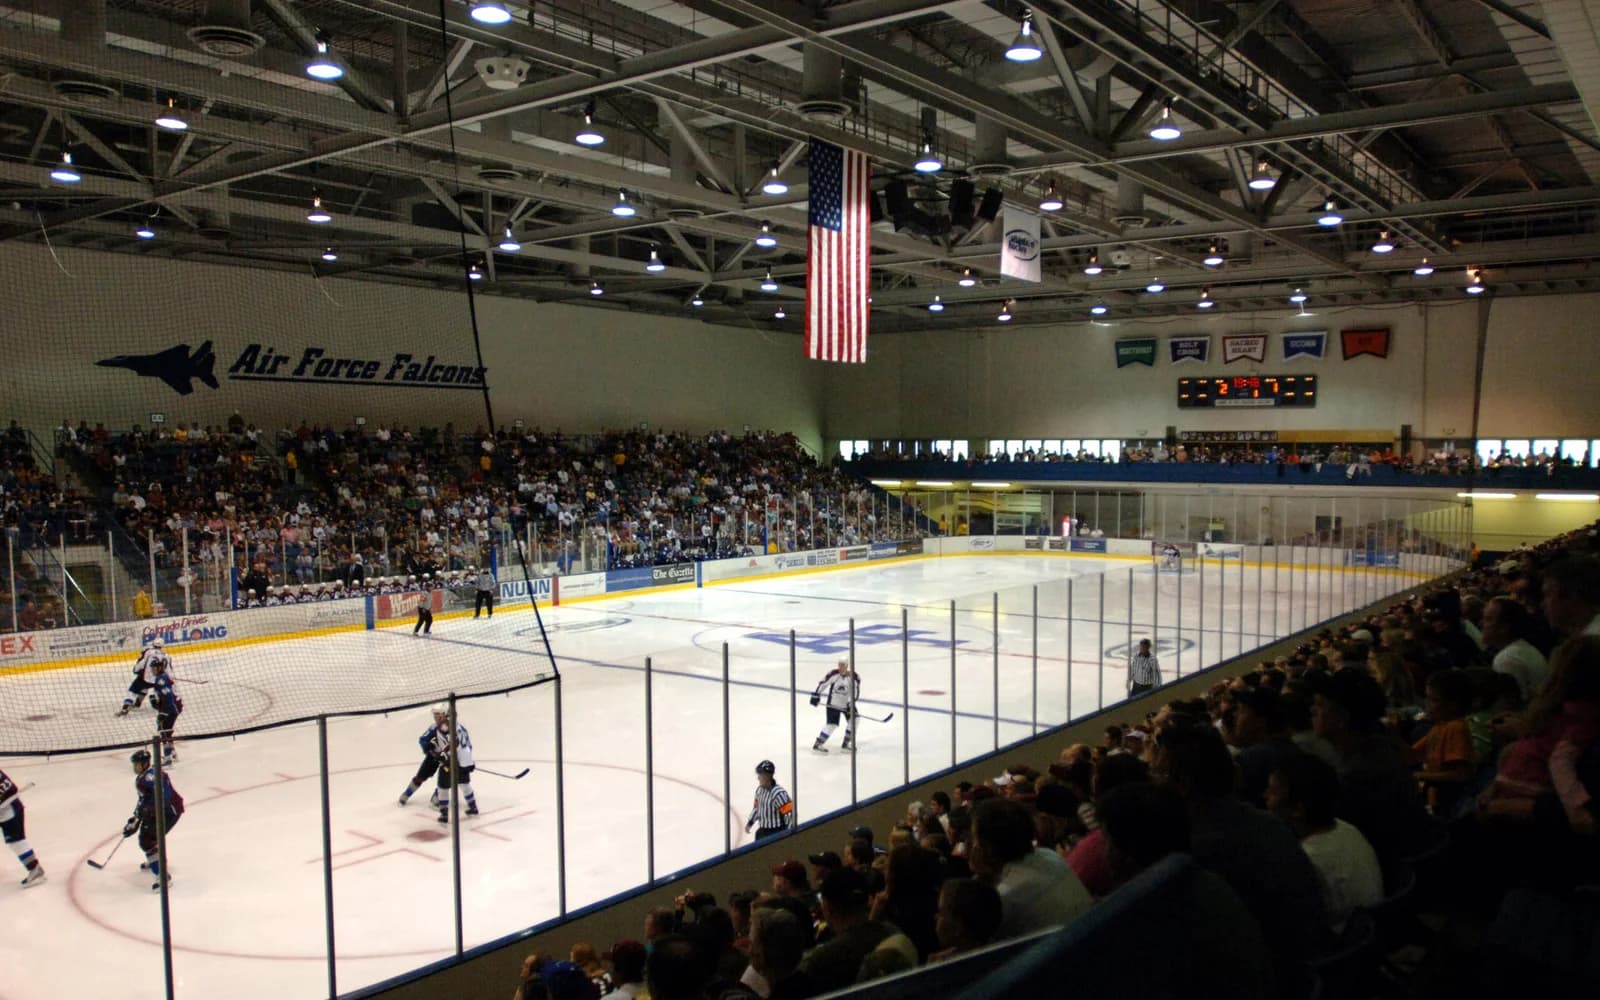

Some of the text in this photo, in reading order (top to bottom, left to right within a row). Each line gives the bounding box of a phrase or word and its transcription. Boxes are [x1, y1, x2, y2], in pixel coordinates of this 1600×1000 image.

[230, 343, 488, 385] Air Force Falcons
[653, 570, 668, 580] The
[669, 567, 694, 578] Gazette
[502, 578, 550, 598] NUNN
[143, 620, 180, 635] Colorado
[181, 616, 208, 628] Drives
[182, 625, 227, 642] LONG
